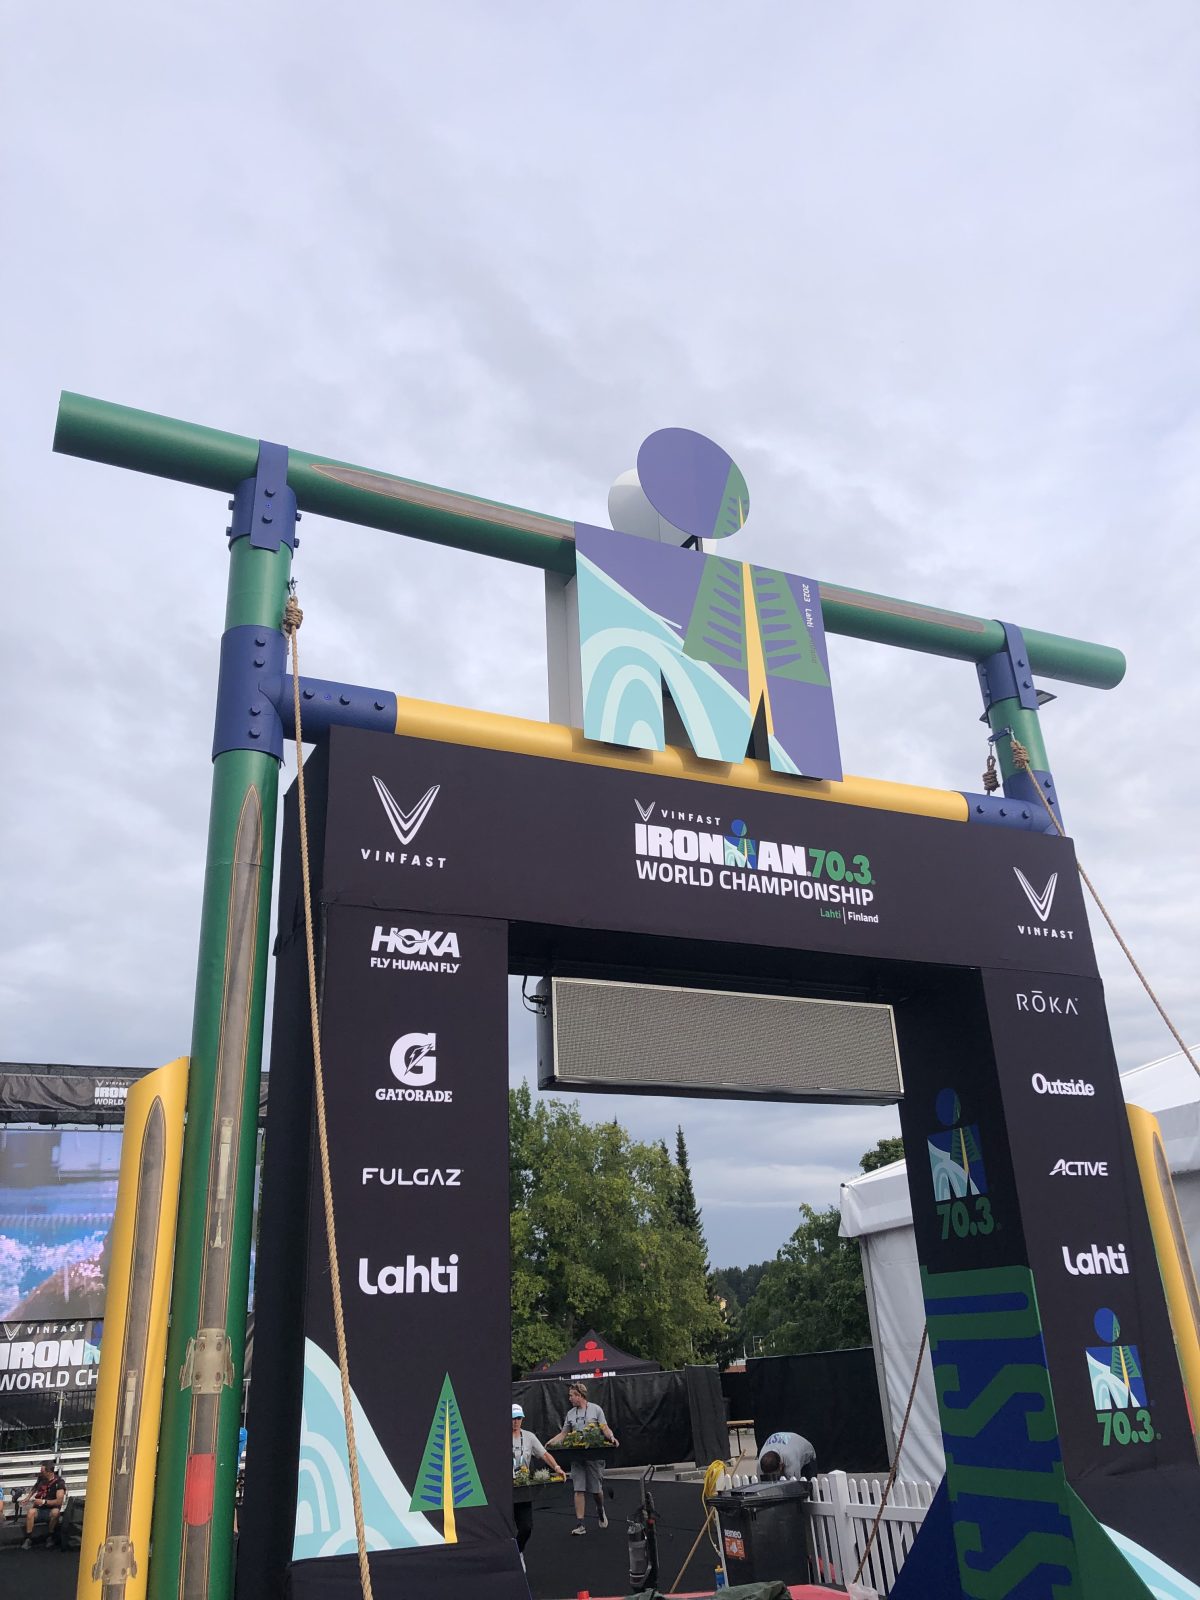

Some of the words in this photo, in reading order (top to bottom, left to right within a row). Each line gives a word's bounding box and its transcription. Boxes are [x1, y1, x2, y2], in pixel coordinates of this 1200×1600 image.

[661, 809, 721, 826] VINFAST
[361, 849, 447, 868] VINFAST
[635, 859, 714, 887] WORLD
[719, 870, 874, 906] CHAMPIONSHIP
[820, 908, 842, 920] Lahti
[848, 911, 879, 923] Finland
[371, 926, 461, 958] HOKA
[1017, 925, 1075, 940] VINFAST
[370, 957, 391, 969] FLY
[392, 958, 440, 972] HUMAN
[440, 962, 460, 974] FLY
[1031, 1073, 1095, 1096] Outside
[94, 1098, 124, 1106] WORLD
[375, 1088, 453, 1103] GATORADE
[362, 1167, 461, 1186] FULGAZ
[1049, 1159, 1108, 1176] ACTIVE
[936, 1197, 995, 1240] 70.3
[1062, 1244, 1130, 1276] Lahti
[358, 1253, 459, 1295] Lahti
[27, 1324, 84, 1335] VINFAST
[0, 1370, 70, 1391] WORLD
[1097, 1409, 1154, 1446] 70.3
